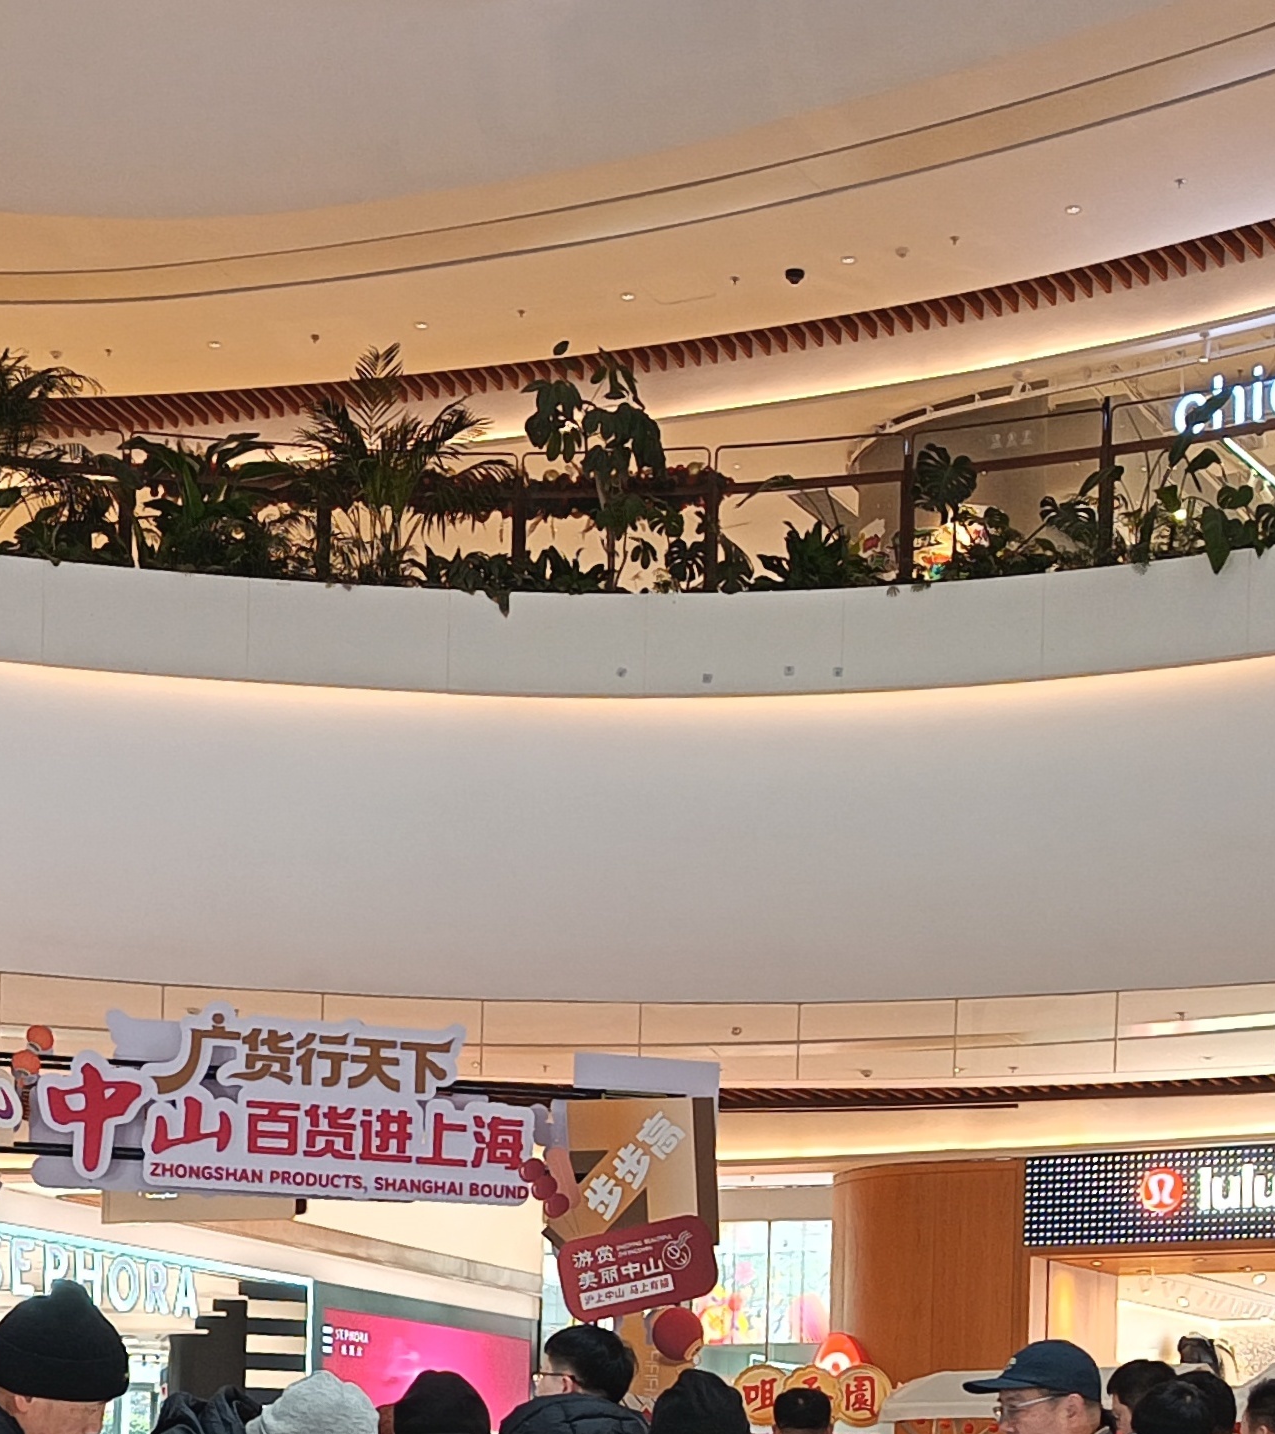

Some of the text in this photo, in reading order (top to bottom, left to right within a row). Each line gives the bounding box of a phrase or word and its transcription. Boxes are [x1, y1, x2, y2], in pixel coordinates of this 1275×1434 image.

[151, 1013, 453, 1094] 广货行天下
[47, 1061, 525, 1173] 中山百货进上海
[150, 1162, 530, 1200] ZHONGSHAN PRODUCTS, SHANGHAI BOUND
[584, 1110, 686, 1221] 步步高
[572, 1244, 617, 1269] 游赏
[578, 1256, 664, 1290] 美丽中山
[335, 1328, 369, 1344] SEPHORA
[743, 1375, 880, 1420] 咀園
